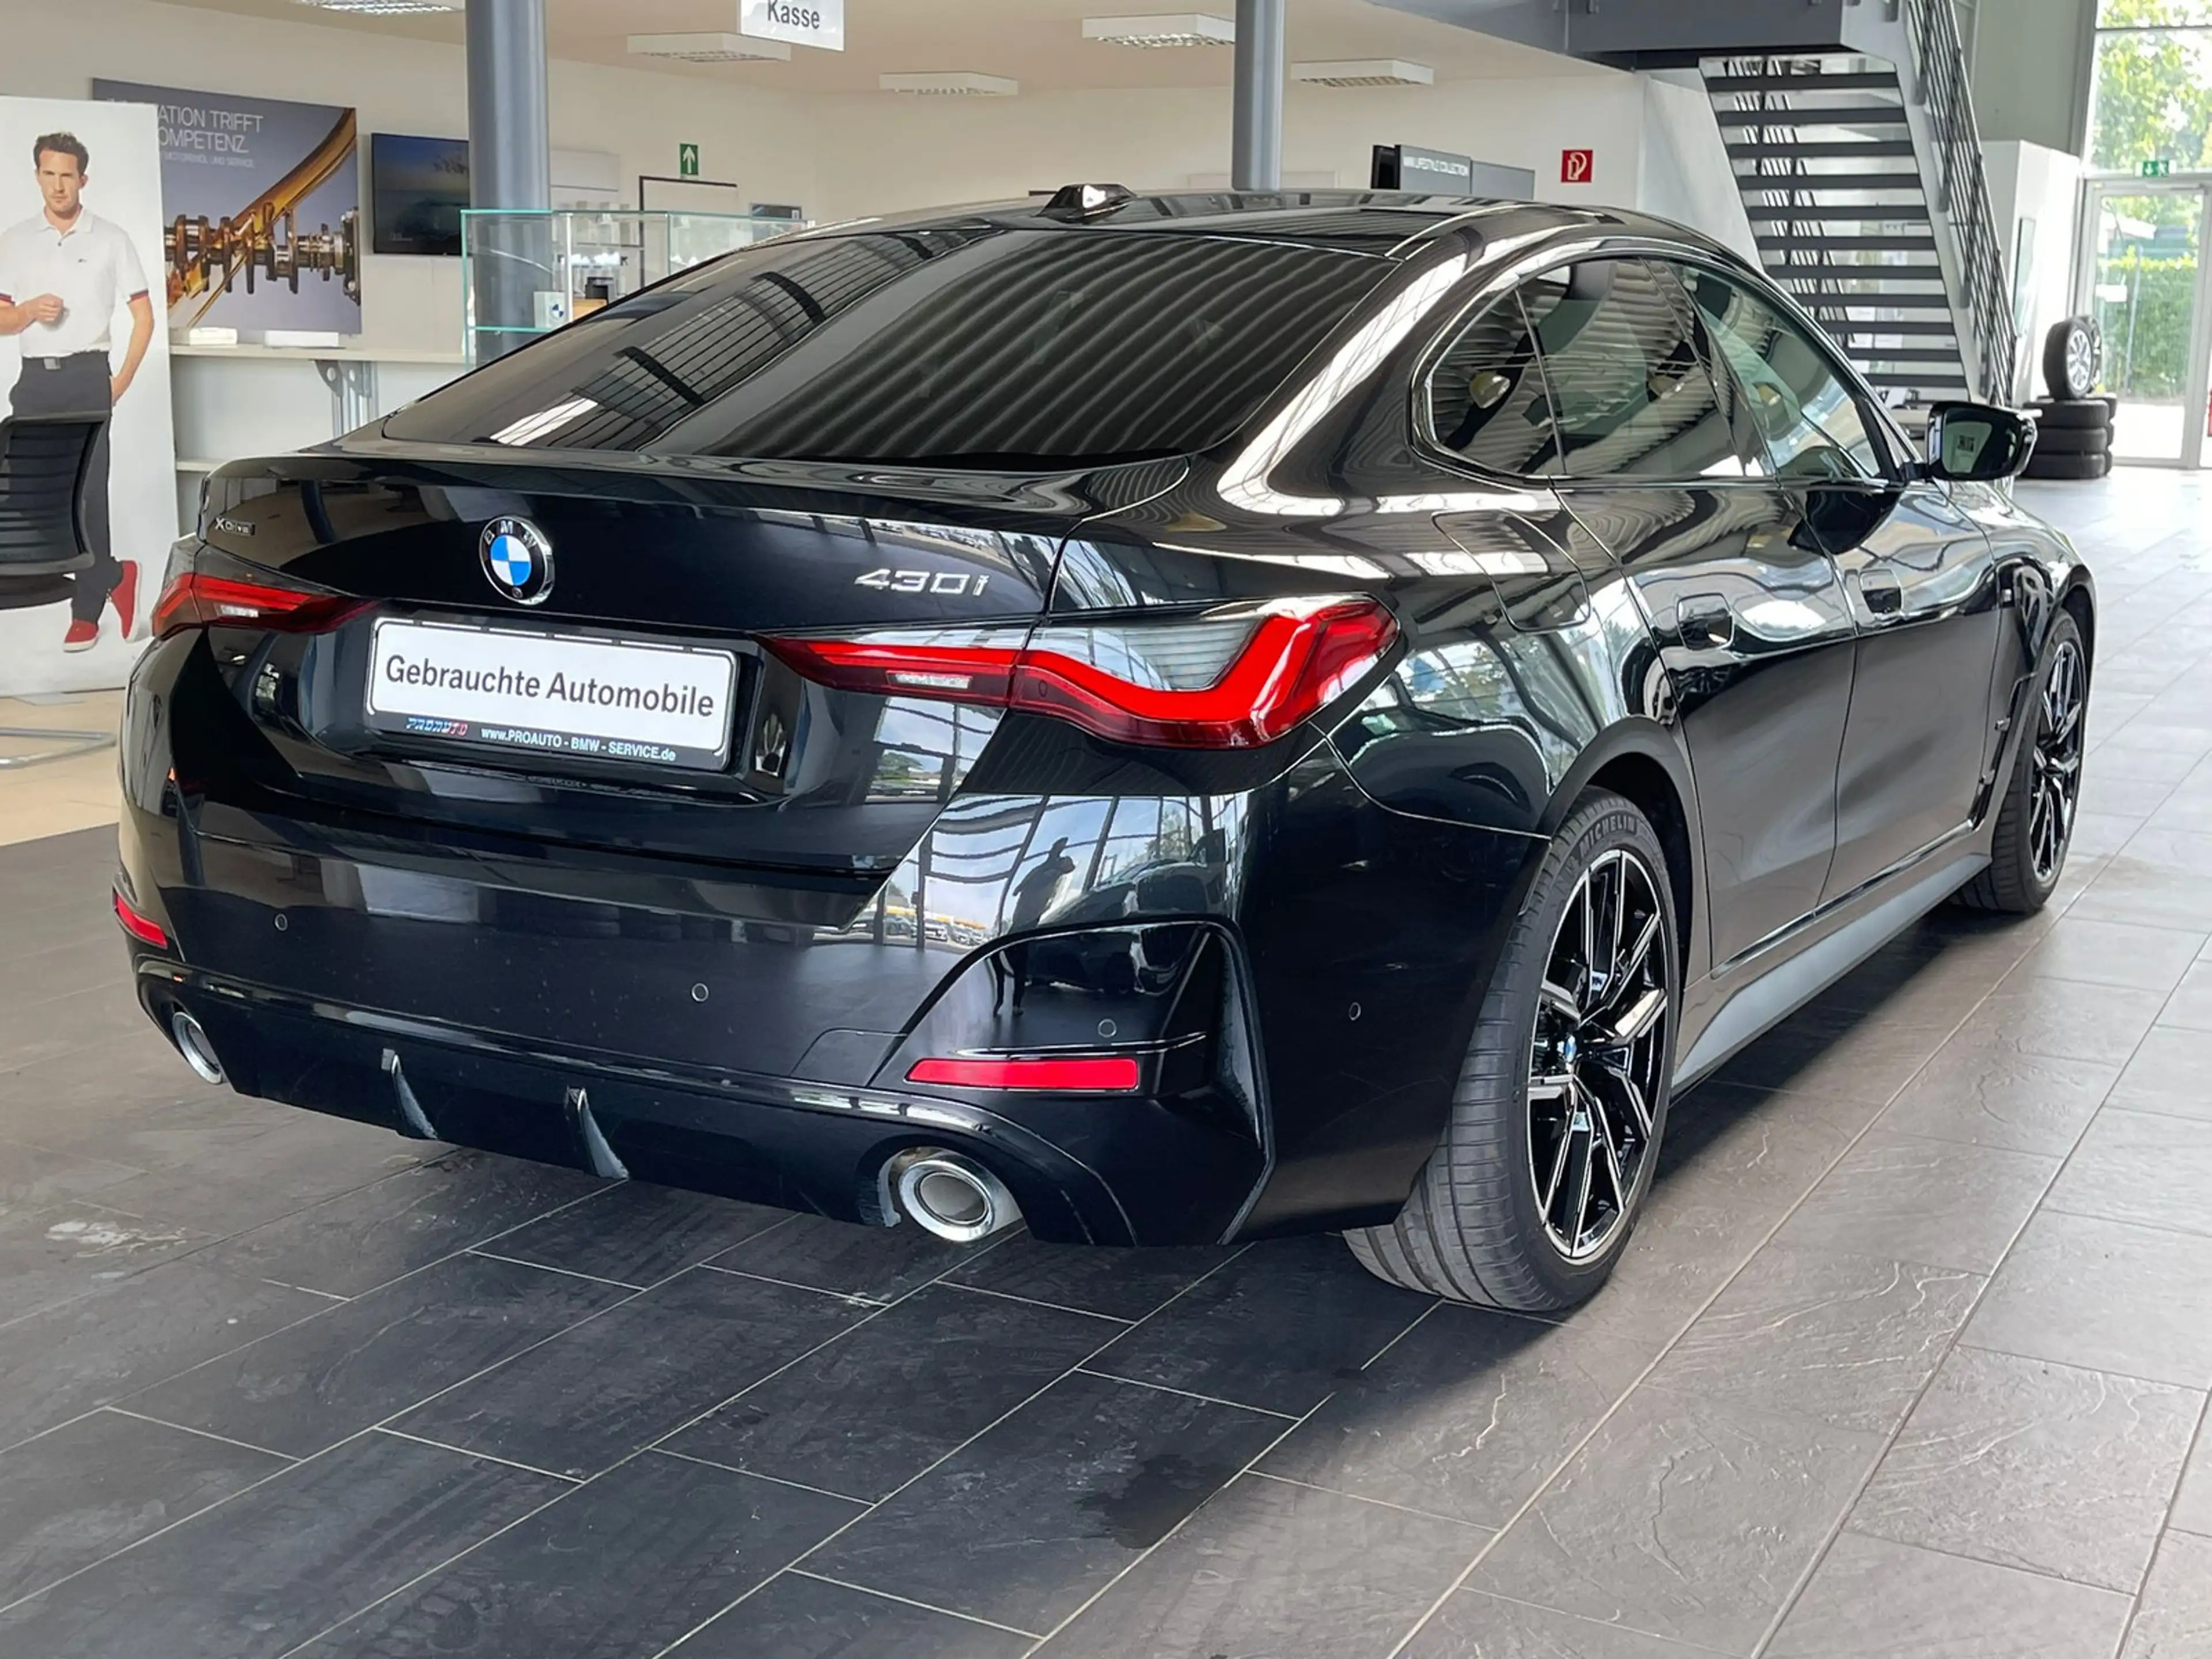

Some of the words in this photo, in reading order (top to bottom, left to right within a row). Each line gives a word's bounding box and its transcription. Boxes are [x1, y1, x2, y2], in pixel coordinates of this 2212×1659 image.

[767, 0, 820, 29] Kasse
[158, 105, 205, 128] ATION
[209, 110, 264, 132] TRIFFT
[158, 126, 249, 153] OMPETENZ
[854, 568, 990, 597] 430i
[385, 654, 540, 698] Gebrauchte
[546, 672, 714, 717] Automobile
[481, 728, 562, 748] www.PROAUTO
[571, 737, 600, 752] BMW
[608, 741, 676, 761] SERVICE.de
[1580, 815, 1636, 858] MICHELIN
